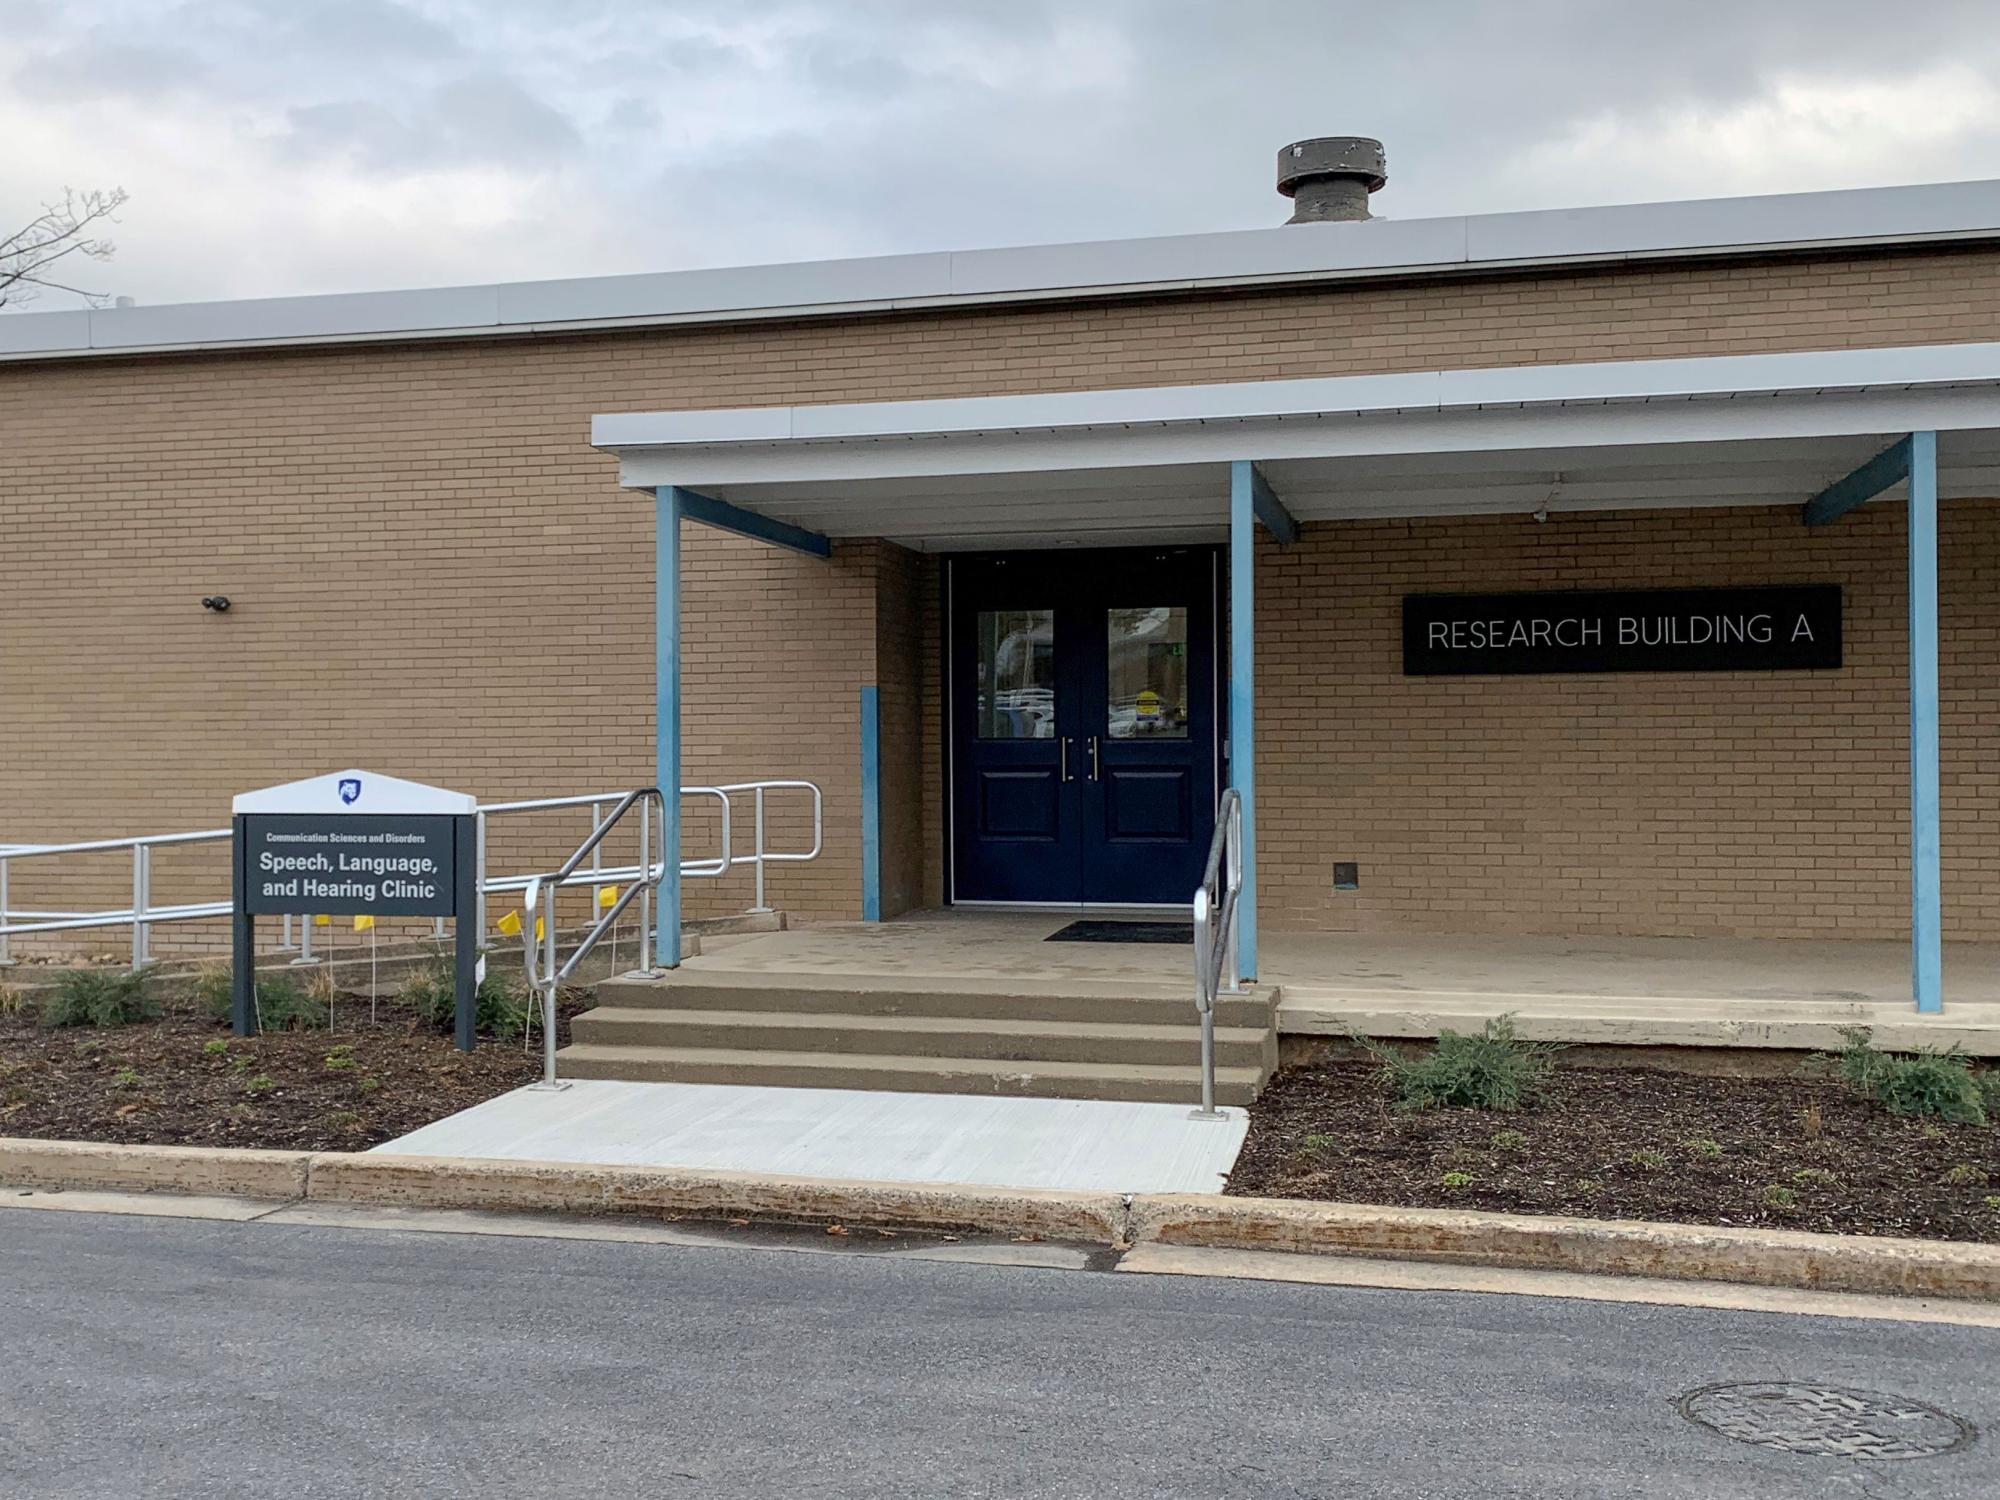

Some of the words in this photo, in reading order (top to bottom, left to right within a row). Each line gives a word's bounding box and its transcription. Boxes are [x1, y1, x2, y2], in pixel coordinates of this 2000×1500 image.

[1429, 618, 1602, 649] RESEARCH
[1618, 614, 1772, 645] BUILDING
[1791, 613, 1815, 642] A
[266, 833, 328, 843] Communication
[330, 833, 367, 843] Sciences
[368, 833, 384, 843] and
[385, 833, 426, 843] Disorders
[259, 852, 334, 874] Speech,
[339, 853, 438, 875] Language,
[262, 879, 297, 897] and
[303, 879, 376, 901] Hearing
[381, 880, 435, 898] Clinic
